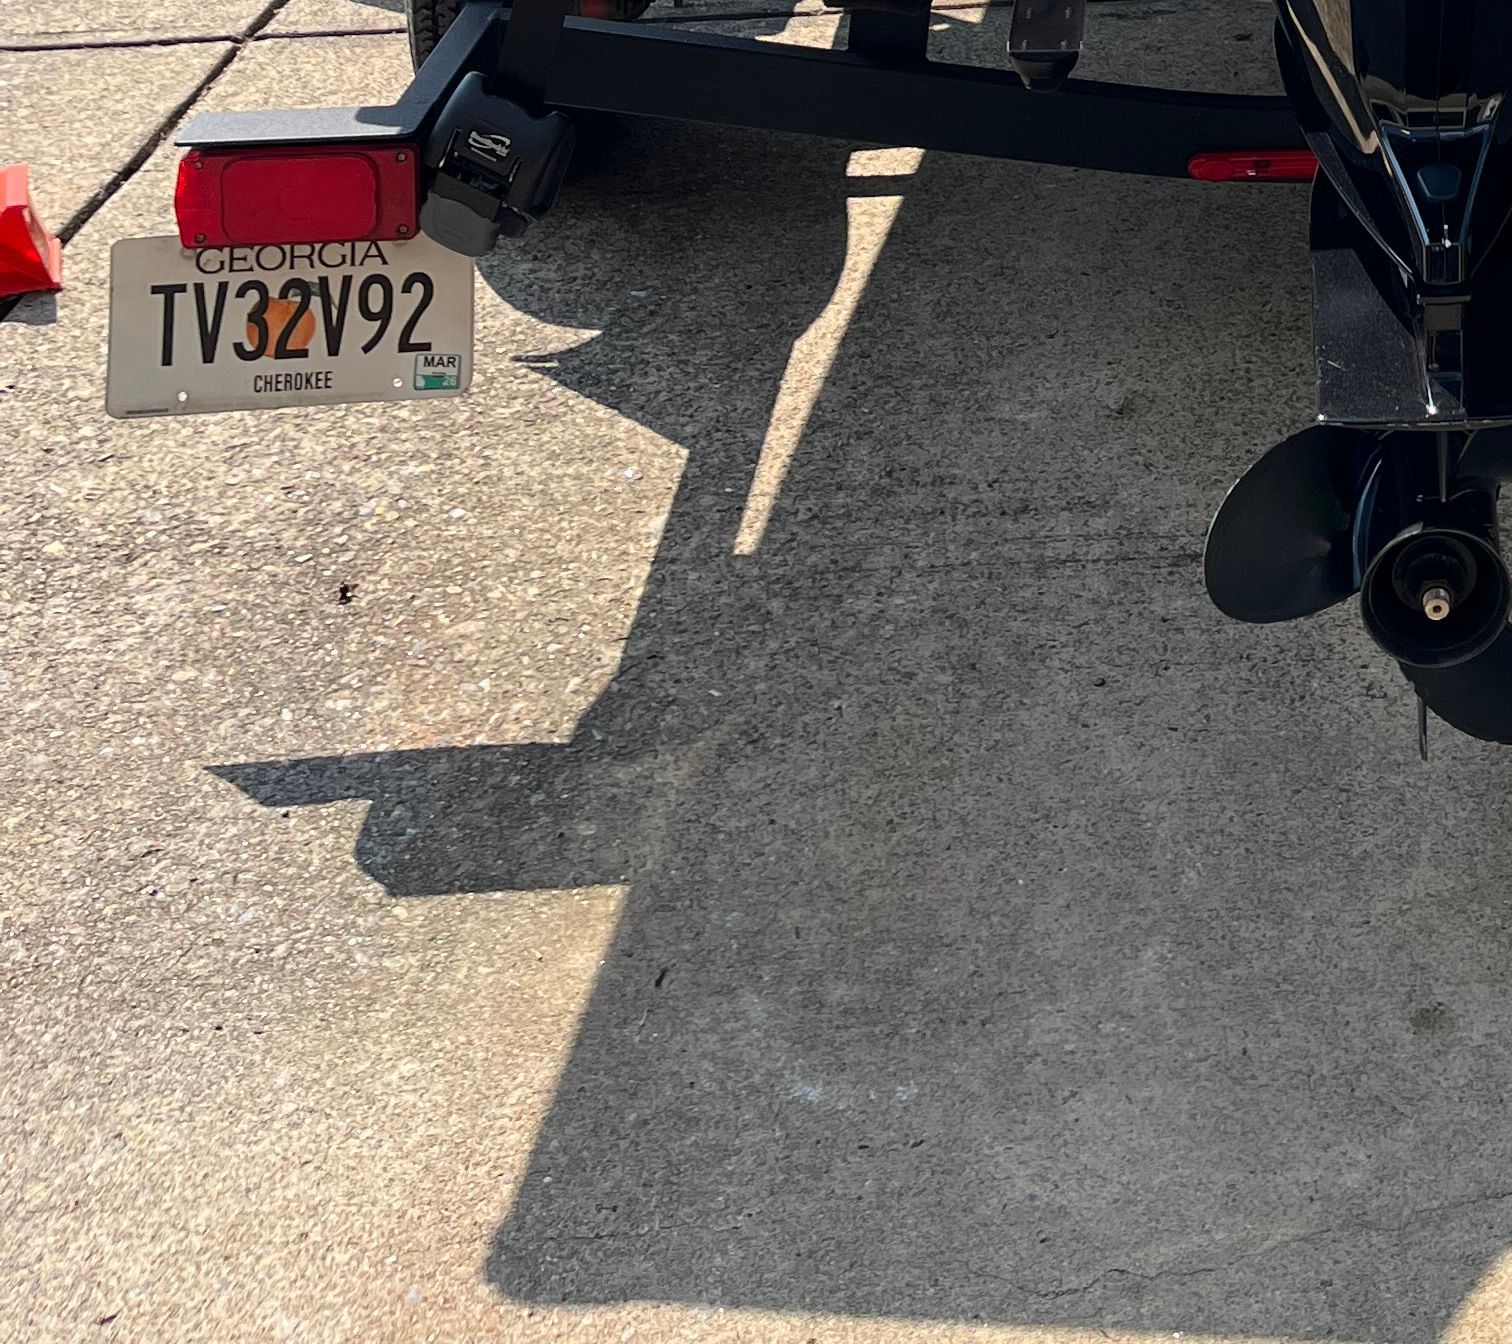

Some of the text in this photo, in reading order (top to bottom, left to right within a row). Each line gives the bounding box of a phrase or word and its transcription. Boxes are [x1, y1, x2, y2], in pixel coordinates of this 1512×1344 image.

[195, 241, 389, 274] GEORGIA
[151, 271, 435, 367] TV32V92
[423, 355, 457, 368] MAR
[253, 370, 334, 393] CHEROKEE
